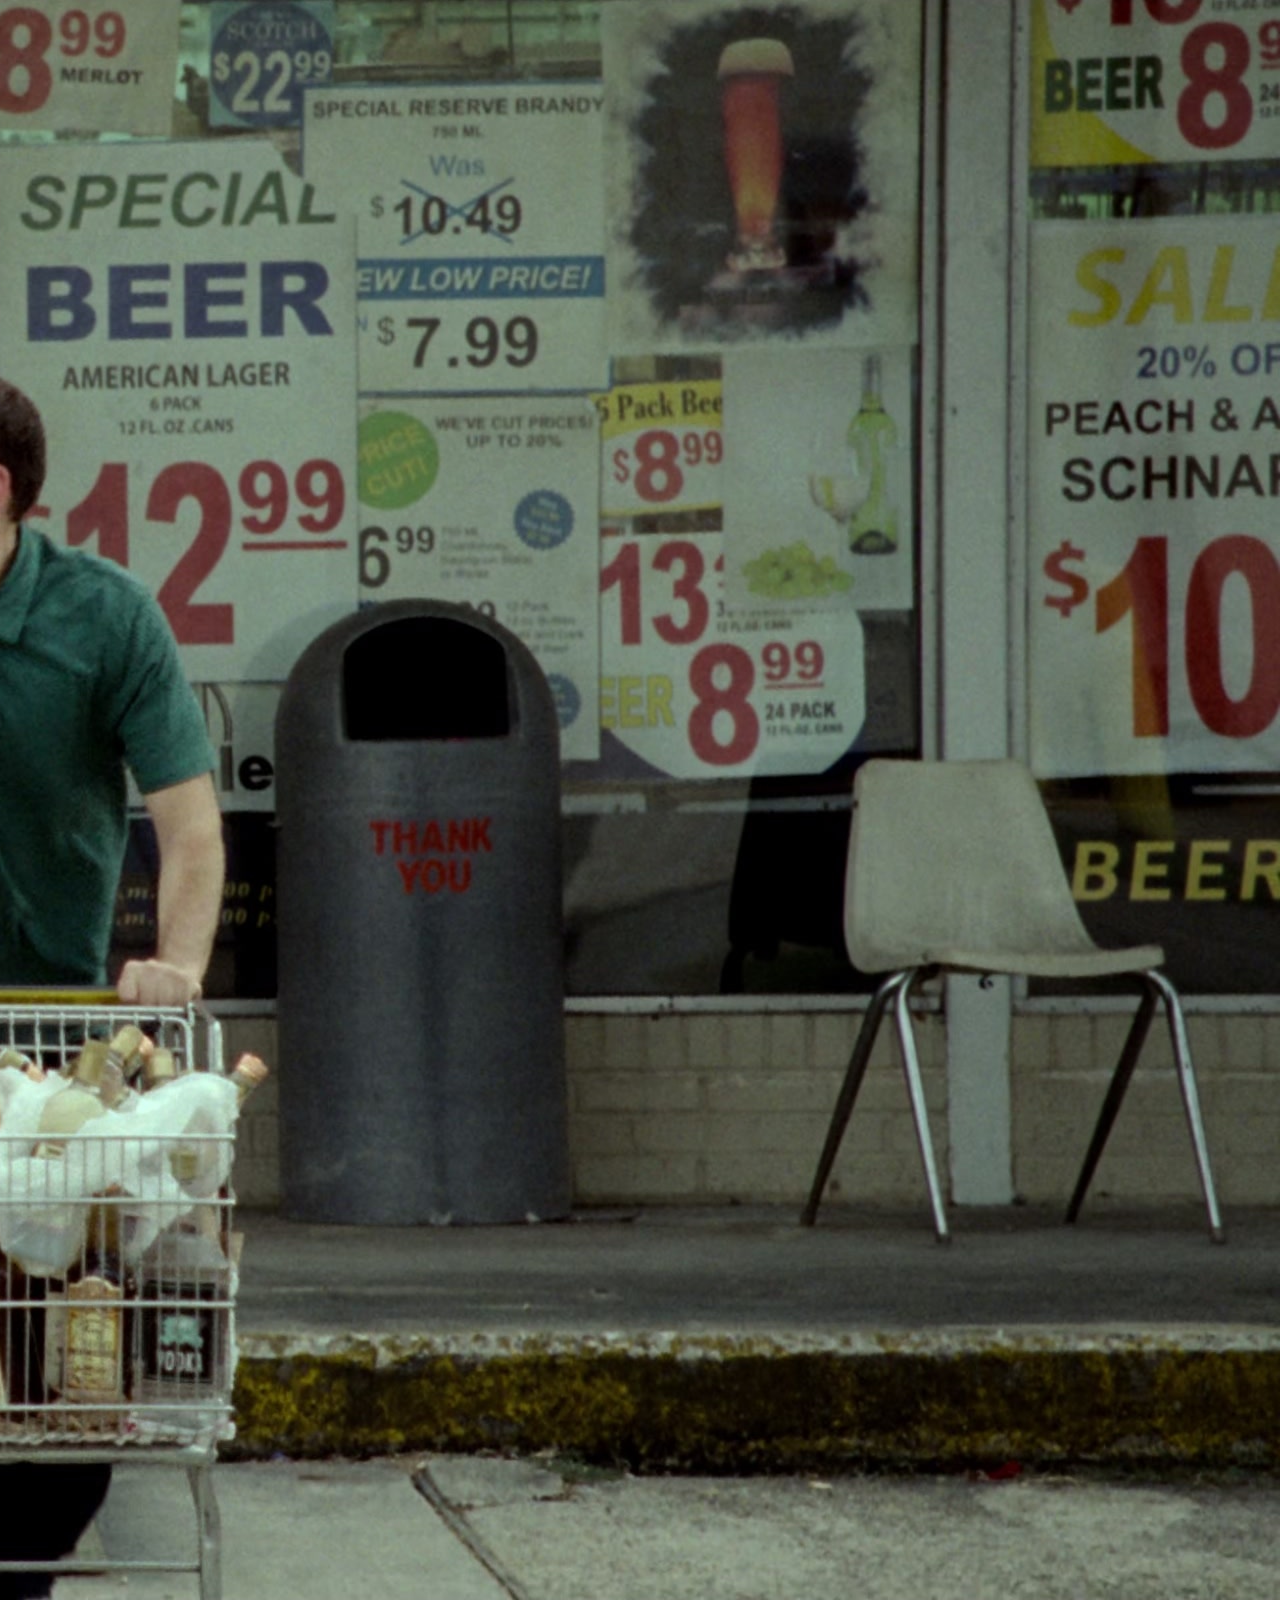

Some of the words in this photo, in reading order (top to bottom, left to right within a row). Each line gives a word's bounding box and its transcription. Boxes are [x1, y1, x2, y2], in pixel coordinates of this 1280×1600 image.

[226, 20, 318, 40] SCOTCH
[60, 68, 144, 85] MERLOT
[1045, 54, 1164, 113] BEER
[313, 100, 402, 119] SPECIAL
[409, 98, 508, 116] RESERVE
[515, 96, 604, 114] BRANDY
[432, 125, 457, 138] 750
[462, 125, 483, 138] ML
[429, 155, 485, 176] Was
[20, 171, 336, 231] SPECIAL
[394, 195, 522, 236] 10.49
[357, 269, 404, 291] EW
[409, 267, 484, 290] LOW
[489, 264, 592, 289] PRICE!
[26, 261, 335, 342] BEER
[406, 316, 539, 368] 7.99
[62, 364, 199, 390] AMERICAN
[206, 361, 290, 387] LAGER
[1137, 345, 1216, 379] 20%
[163, 396, 201, 411] PACK
[617, 391, 674, 421] Pack
[1046, 400, 1194, 435] PEACH
[1211, 398, 1239, 431] &
[492, 416, 523, 429] CUT
[465, 435, 492, 448] UP
[497, 434, 521, 447] TO
[525, 434, 563, 447] 20%
[765, 703, 785, 720] 24
[790, 701, 836, 718] PACK
[369, 816, 493, 855] THANK
[396, 860, 472, 895] YOU
[158, 1350, 203, 1374] VODKA
